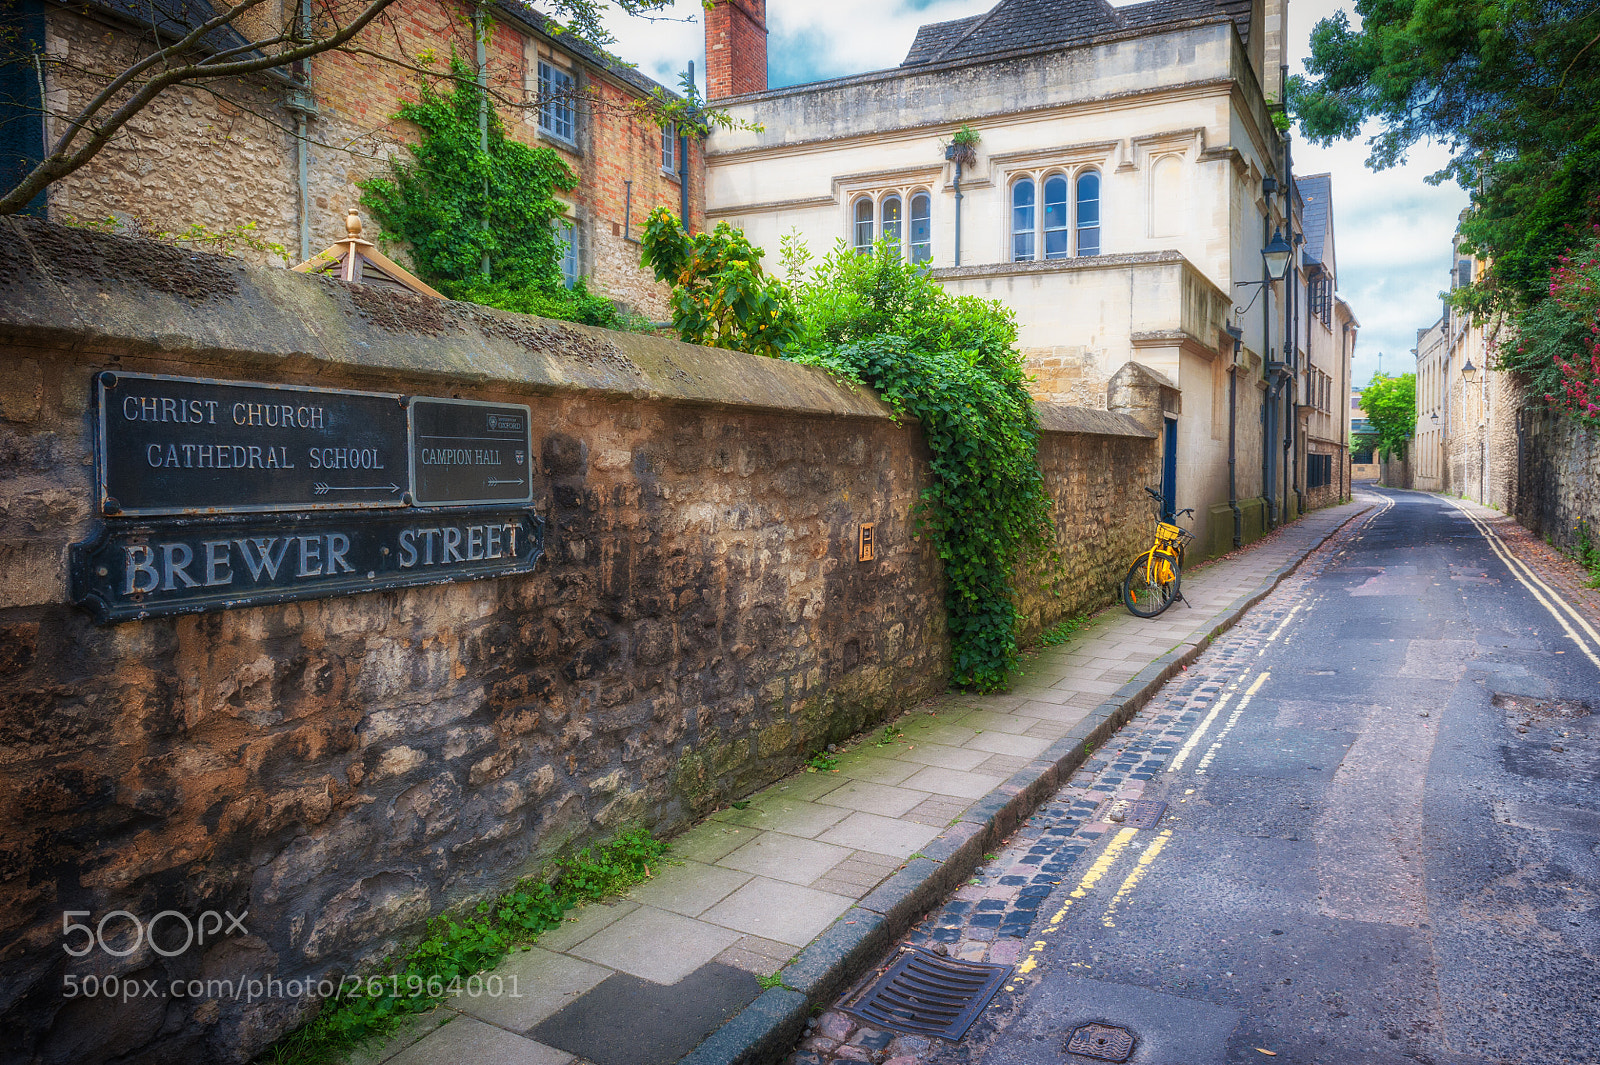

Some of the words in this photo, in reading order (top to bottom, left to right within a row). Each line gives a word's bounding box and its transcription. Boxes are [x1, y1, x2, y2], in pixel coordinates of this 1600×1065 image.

[122, 396, 219, 426] CHRIST
[232, 403, 325, 430] CHURCH
[146, 444, 295, 470] CATHEDRAL
[308, 447, 385, 471] SCHOOL
[421, 448, 472, 465] CAMPION
[474, 449, 502, 465] HALL
[122, 533, 356, 596] BREWER
[399, 522, 524, 568] STREET
